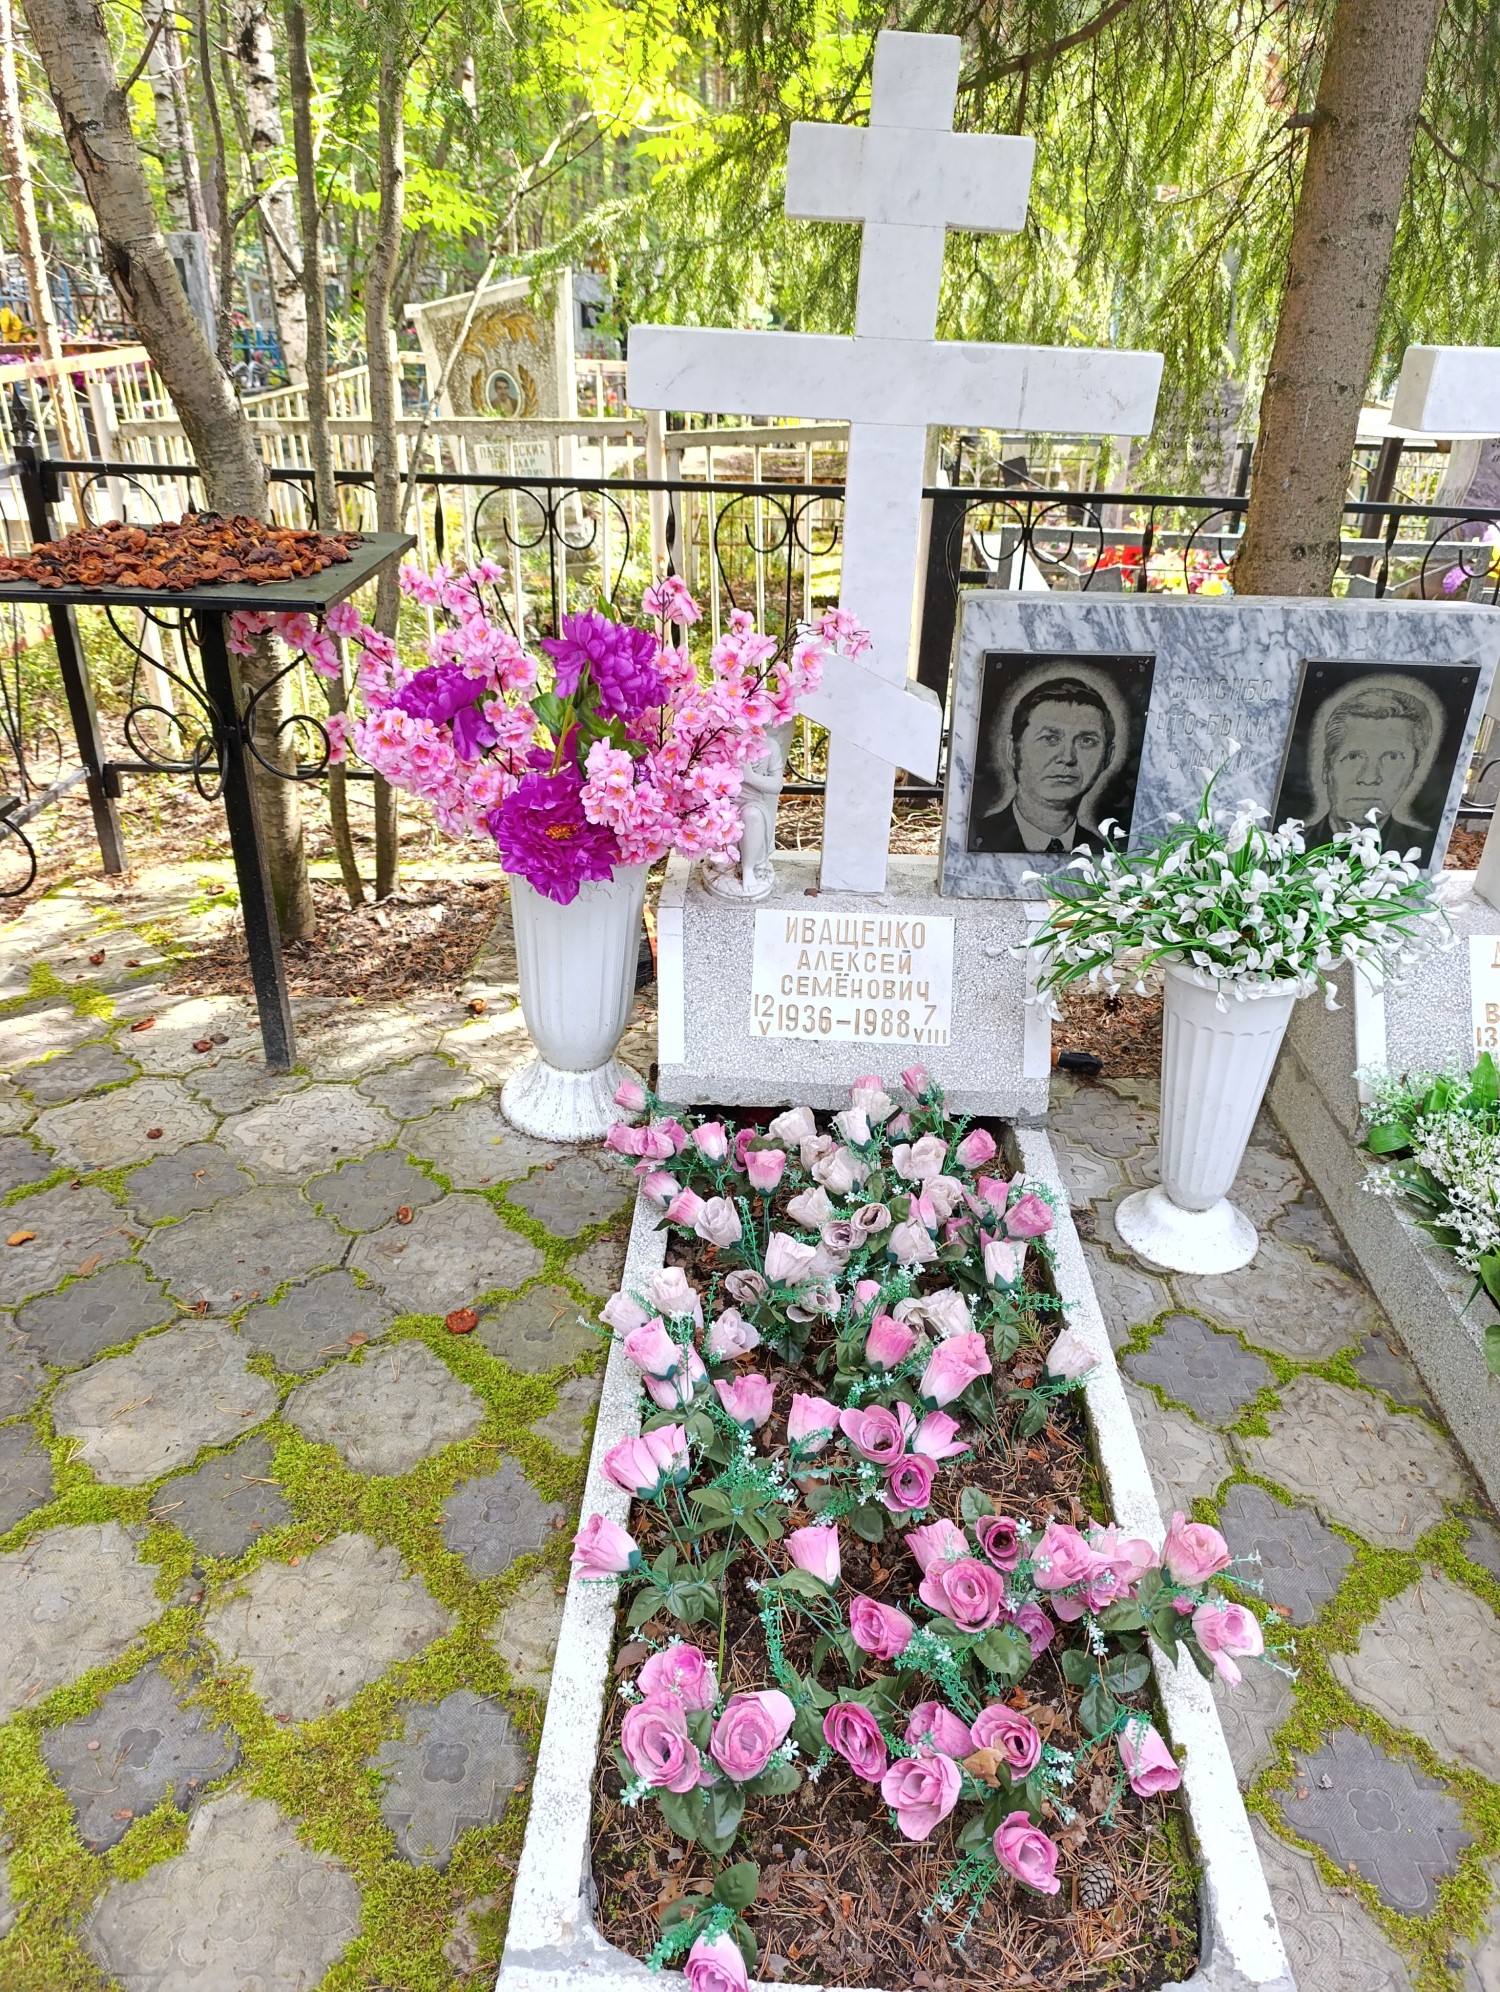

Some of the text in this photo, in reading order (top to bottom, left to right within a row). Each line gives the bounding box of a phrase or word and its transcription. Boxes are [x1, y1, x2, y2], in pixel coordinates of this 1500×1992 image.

[1172, 676, 1272, 701] СПАСИБО
[1156, 712, 1270, 738] ЧТО БЫЛИ
[1169, 749, 1181, 770] С
[785, 916, 926, 950] ИВАЩЕНКО
[797, 950, 912, 975] АЛЕКСЕЙ
[780, 973, 930, 1002] СЕМЁНОВИЧ
[753, 994, 775, 1018] 12
[924, 1004, 937, 1026] 7
[758, 1020, 771, 1036] V
[913, 1027, 947, 1045] VIII
